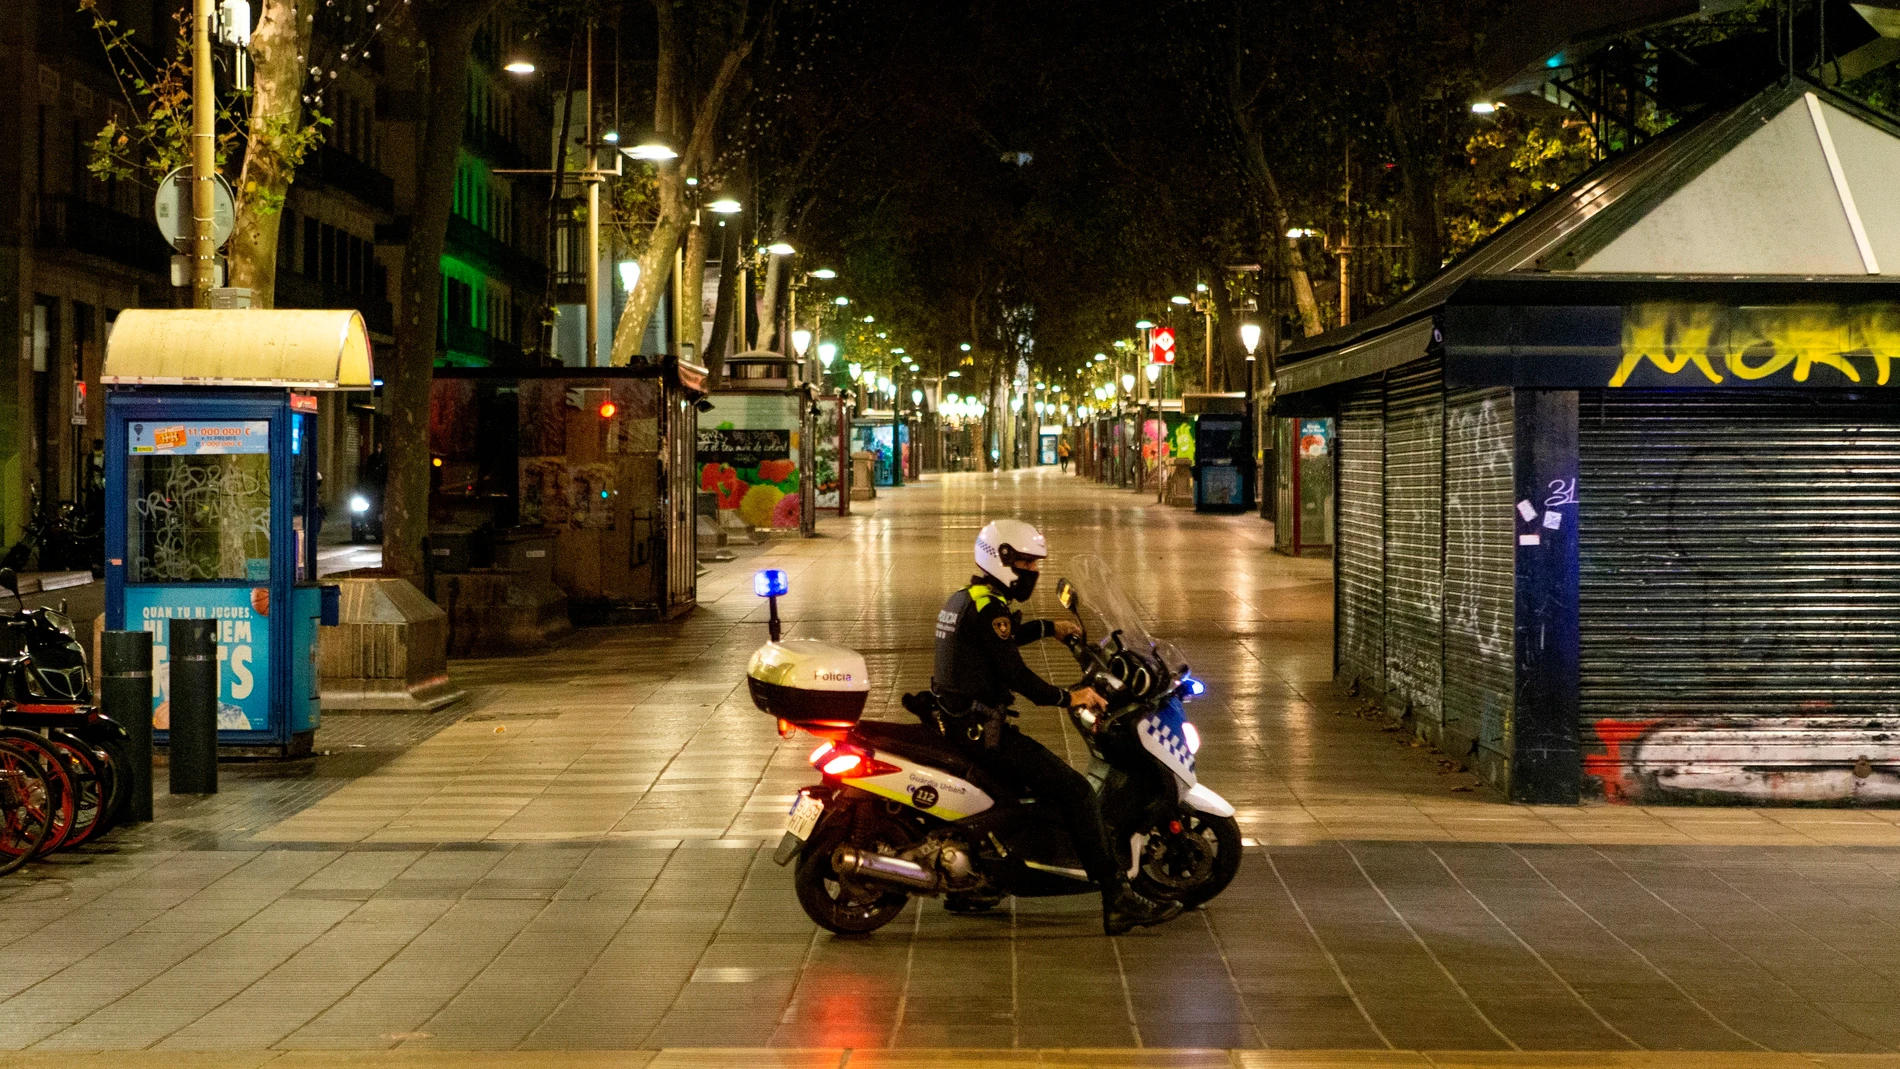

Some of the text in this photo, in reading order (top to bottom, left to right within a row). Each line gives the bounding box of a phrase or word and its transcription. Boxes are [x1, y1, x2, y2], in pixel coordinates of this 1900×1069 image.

[142, 606, 172, 619] QUAN
[177, 606, 191, 618] TU
[195, 606, 206, 618] HI
[916, 790, 935, 802] 112
